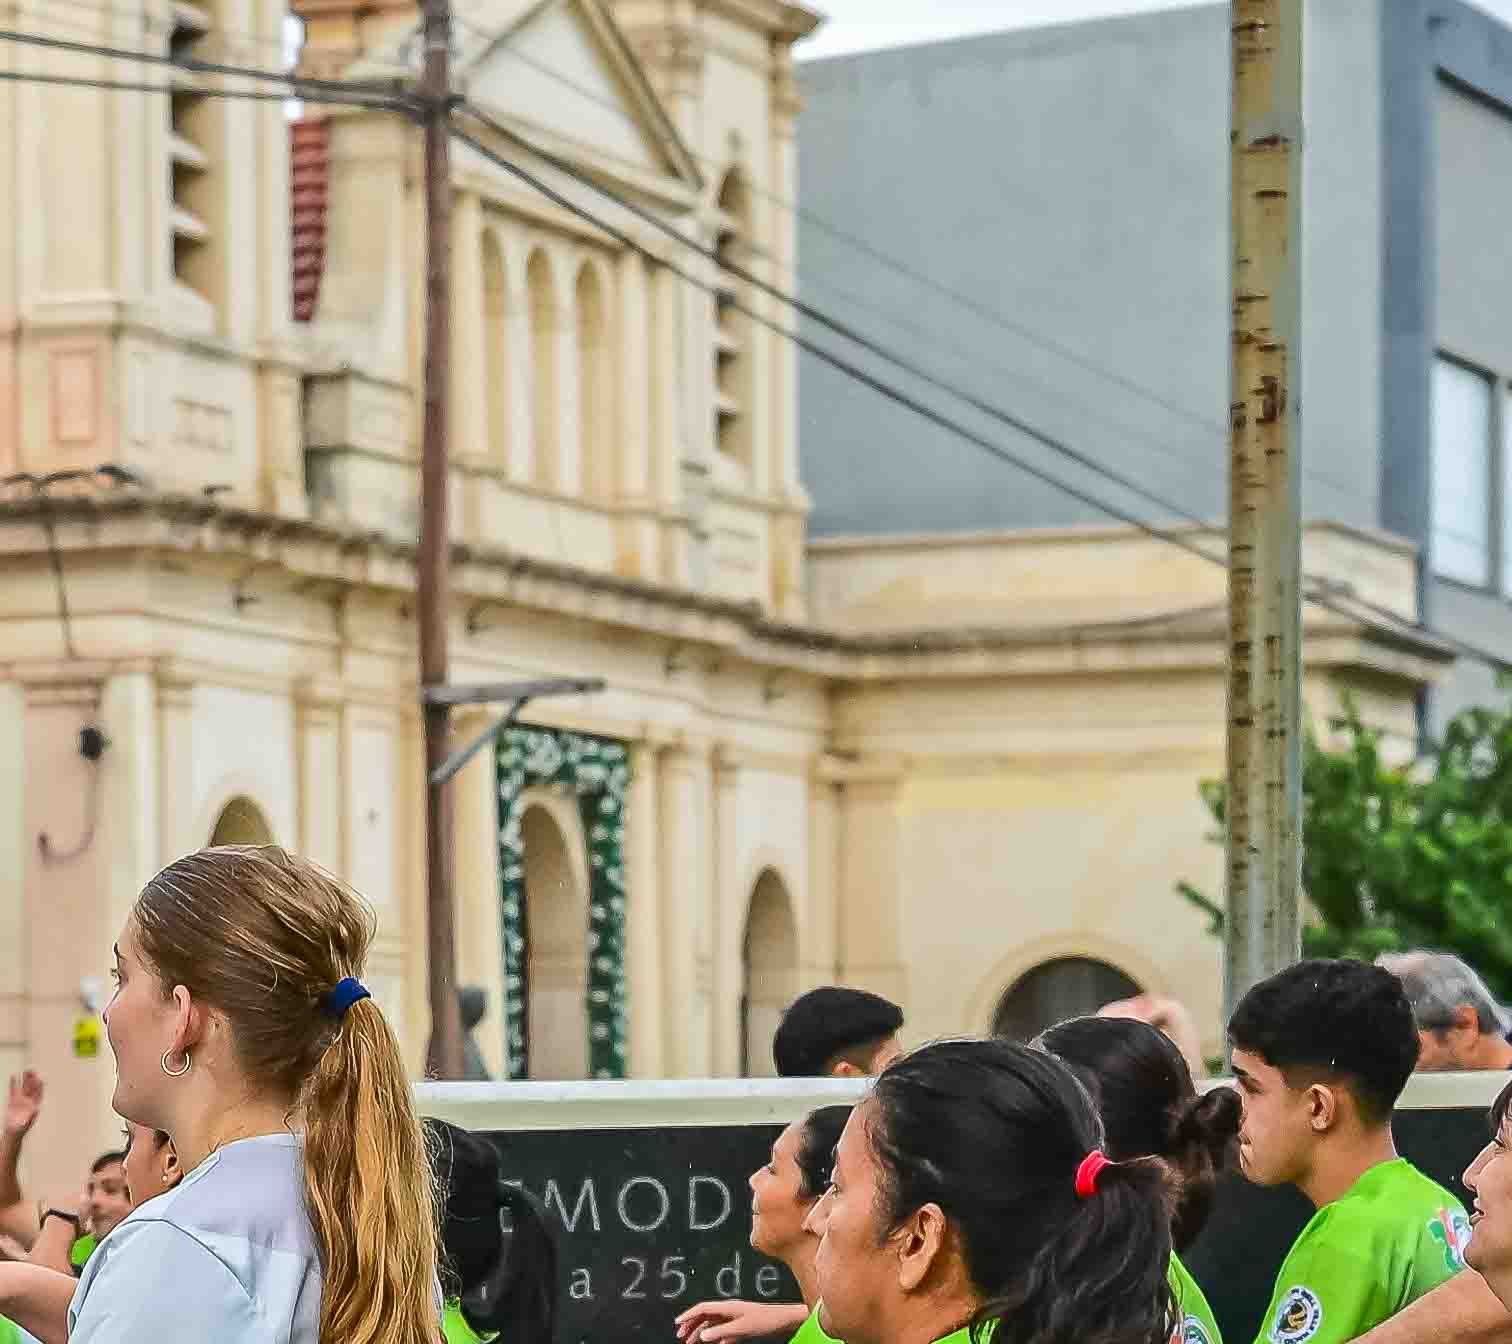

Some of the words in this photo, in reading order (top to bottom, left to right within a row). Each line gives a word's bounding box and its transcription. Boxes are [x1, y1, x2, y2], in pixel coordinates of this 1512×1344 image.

[569, 1267, 593, 1300] a
[621, 1255, 688, 1298] 25
[715, 1250, 780, 1297] de
